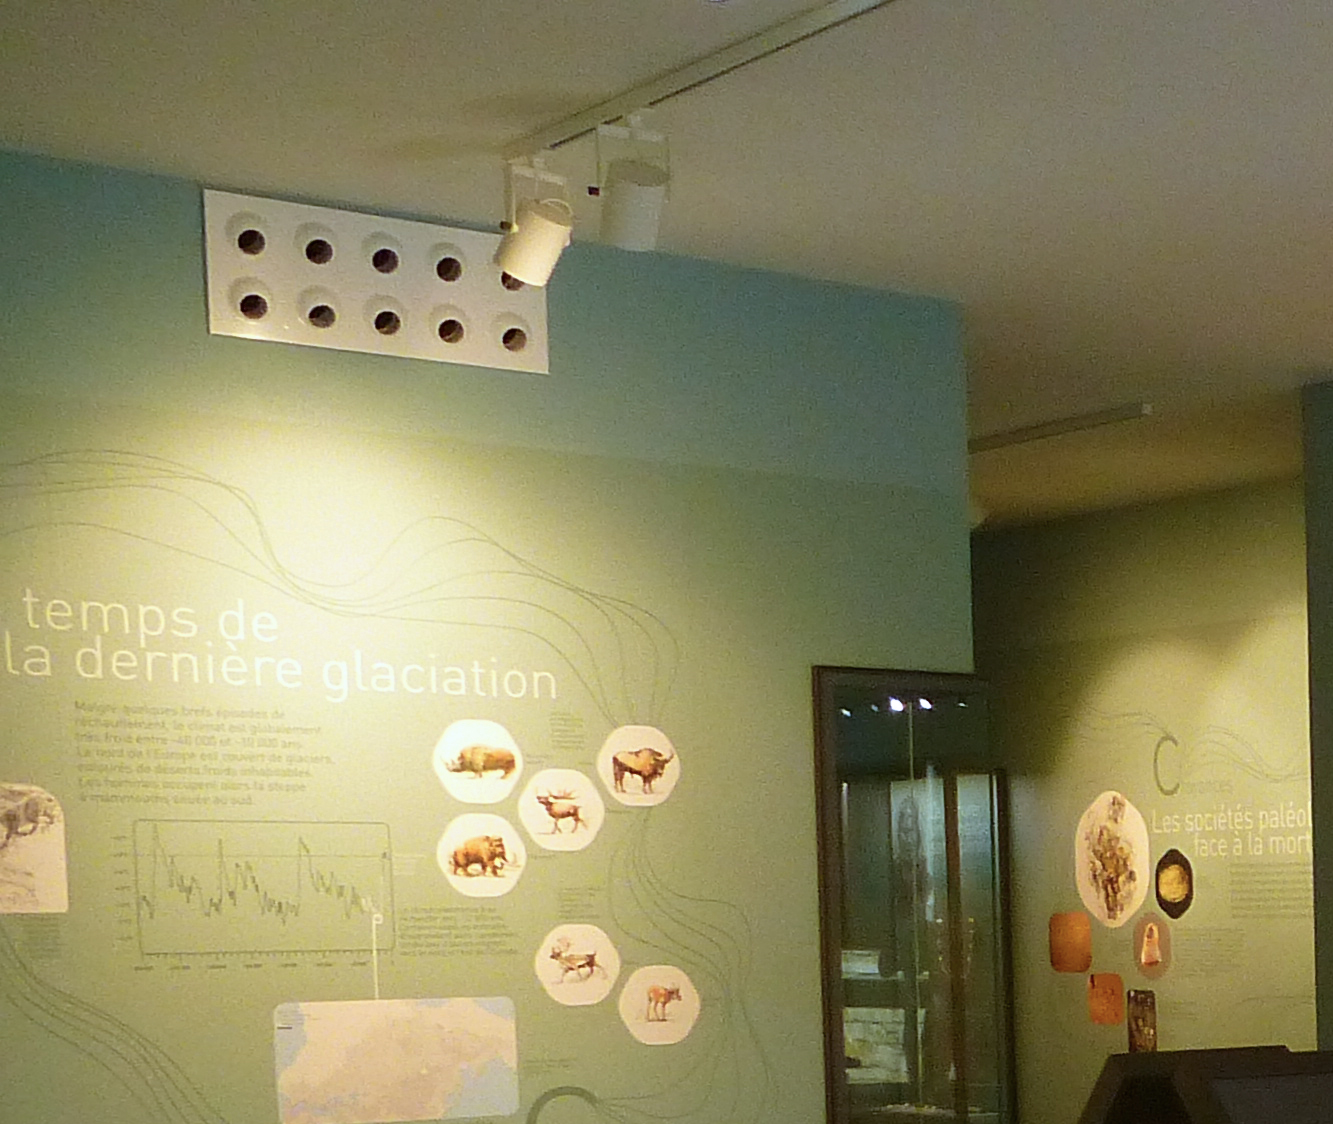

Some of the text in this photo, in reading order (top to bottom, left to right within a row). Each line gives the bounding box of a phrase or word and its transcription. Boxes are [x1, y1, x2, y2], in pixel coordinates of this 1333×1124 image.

[23, 588, 280, 648] temps de
[5, 630, 557, 703] la dernière glaciation
[1152, 809, 1180, 834] Les
[1185, 804, 1253, 833] sociétés
[1195, 832, 1228, 858] face
[1233, 831, 1243, 857] à
[1249, 832, 1263, 856] la
